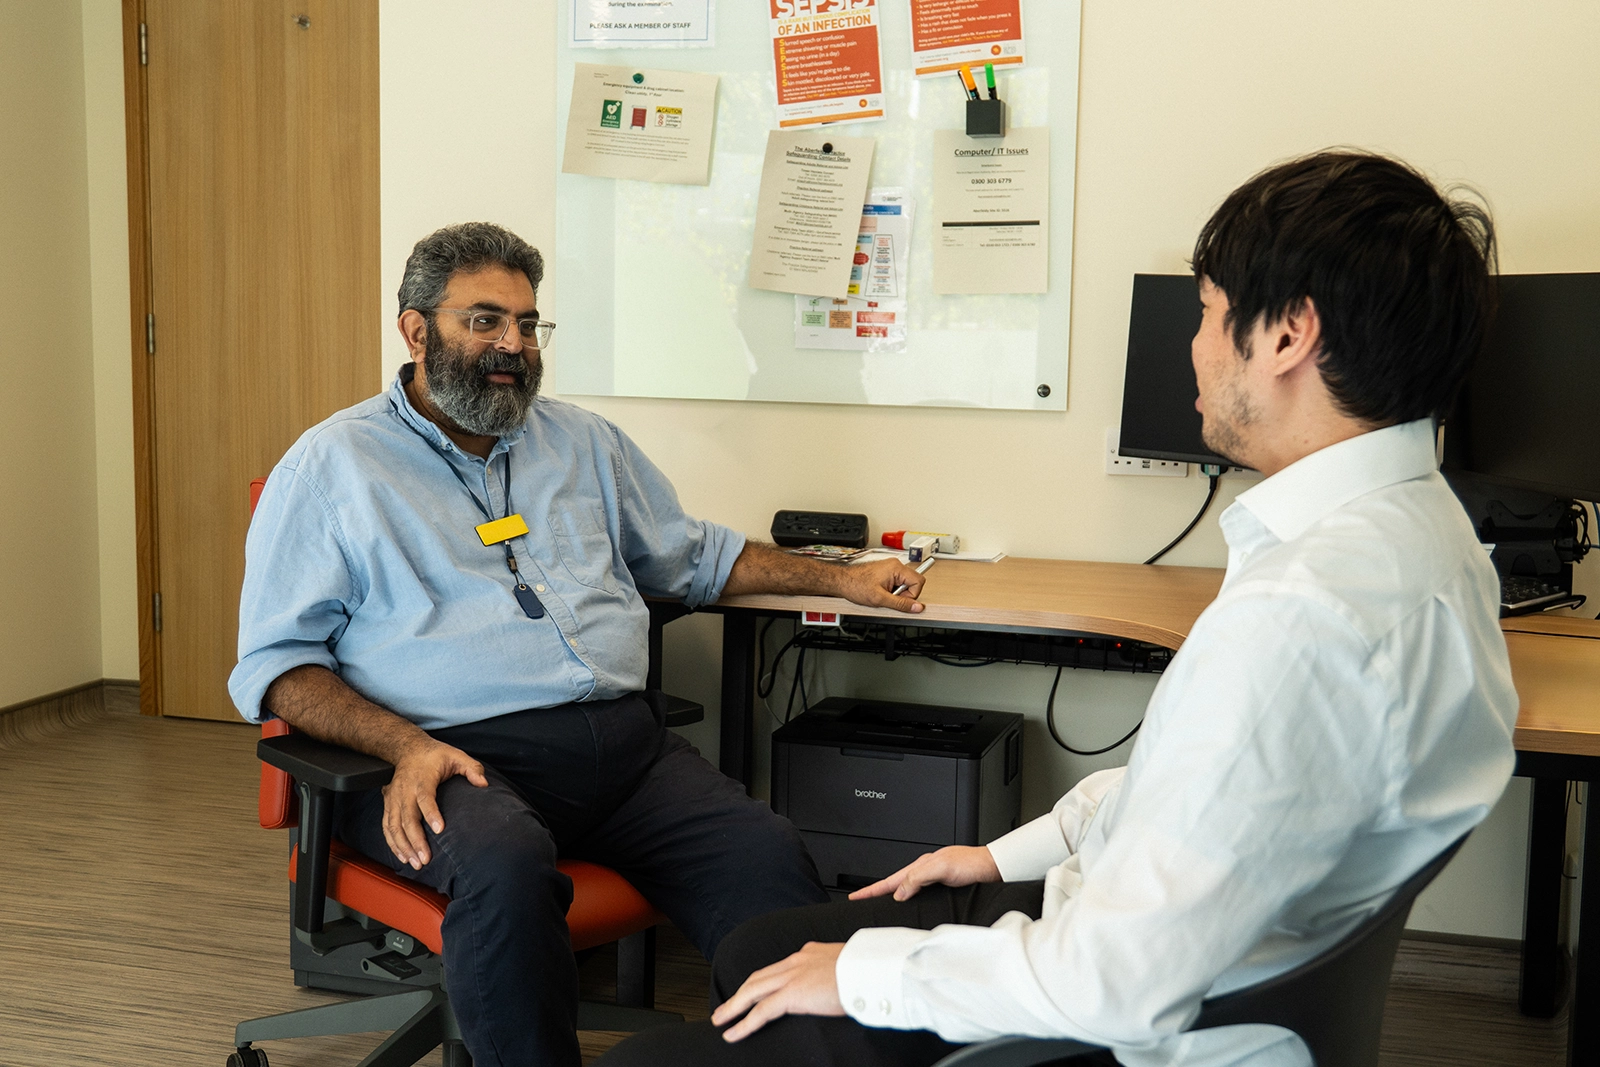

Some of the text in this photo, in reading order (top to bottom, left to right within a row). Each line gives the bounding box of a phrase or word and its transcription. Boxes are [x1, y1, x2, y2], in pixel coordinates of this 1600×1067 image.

[778, 15, 871, 35] OF AN INFECTION
[780, 38, 799, 47] Slurred
[800, 37, 815, 45] speech
[780, 45, 802, 54] Extreme
[803, 45, 823, 53] shivering
[781, 54, 799, 64] Passing
[781, 60, 833, 70] Severe breathlessness
[808, 69, 823, 77] you're
[782, 78, 794, 87] Skin
[815, 74, 842, 82] discoloured
[786, 151, 818, 160] Safeguarding
[954, 148, 996, 156] Computer/
[855, 789, 886, 799] brother
